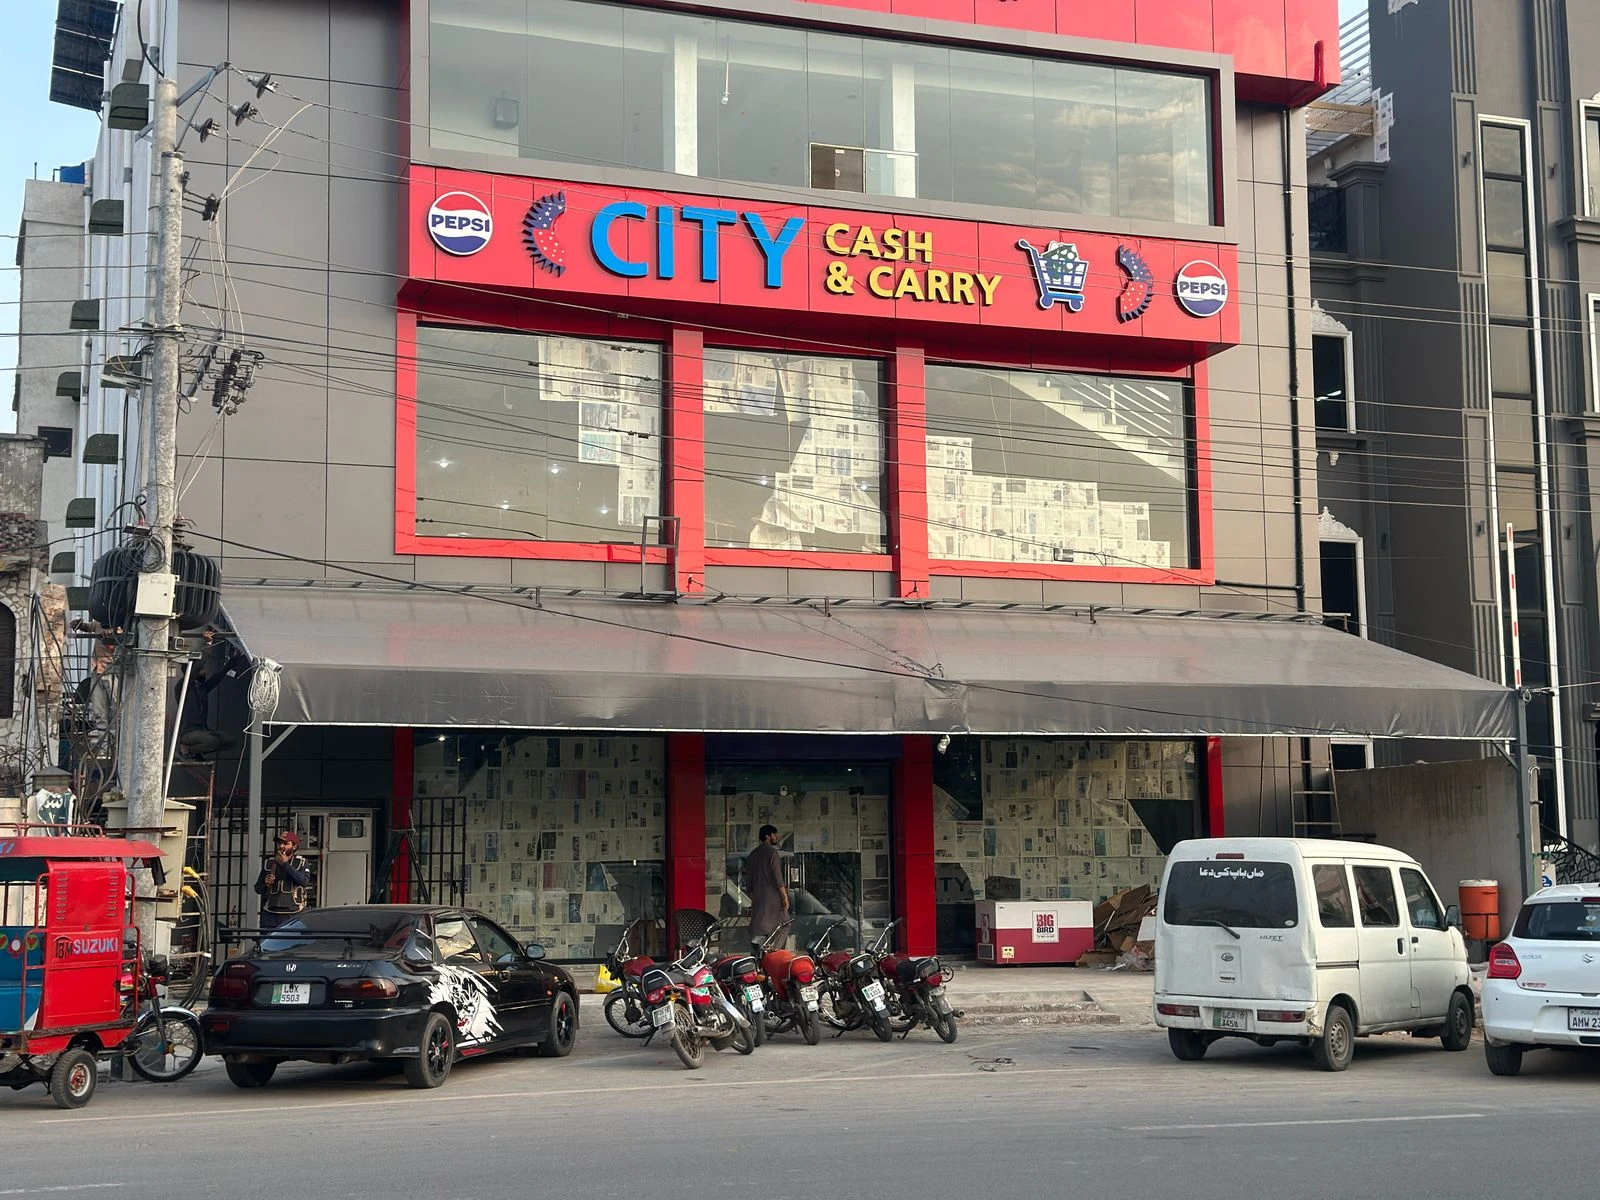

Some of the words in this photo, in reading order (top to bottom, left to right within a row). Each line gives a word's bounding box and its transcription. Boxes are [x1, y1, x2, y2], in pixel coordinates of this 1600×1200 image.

[431, 213, 491, 233] PEPSI
[591, 201, 805, 289] CITY
[825, 223, 934, 263] CASH
[826, 260, 855, 295] &
[868, 266, 1003, 306] CARRY
[1178, 280, 1228, 297] PEPSI
[1036, 914, 1054, 926] BIG
[73, 937, 118, 955] SUZUKI
[281, 994, 300, 1002] 5503
[1572, 1017, 1590, 1028] AMW
